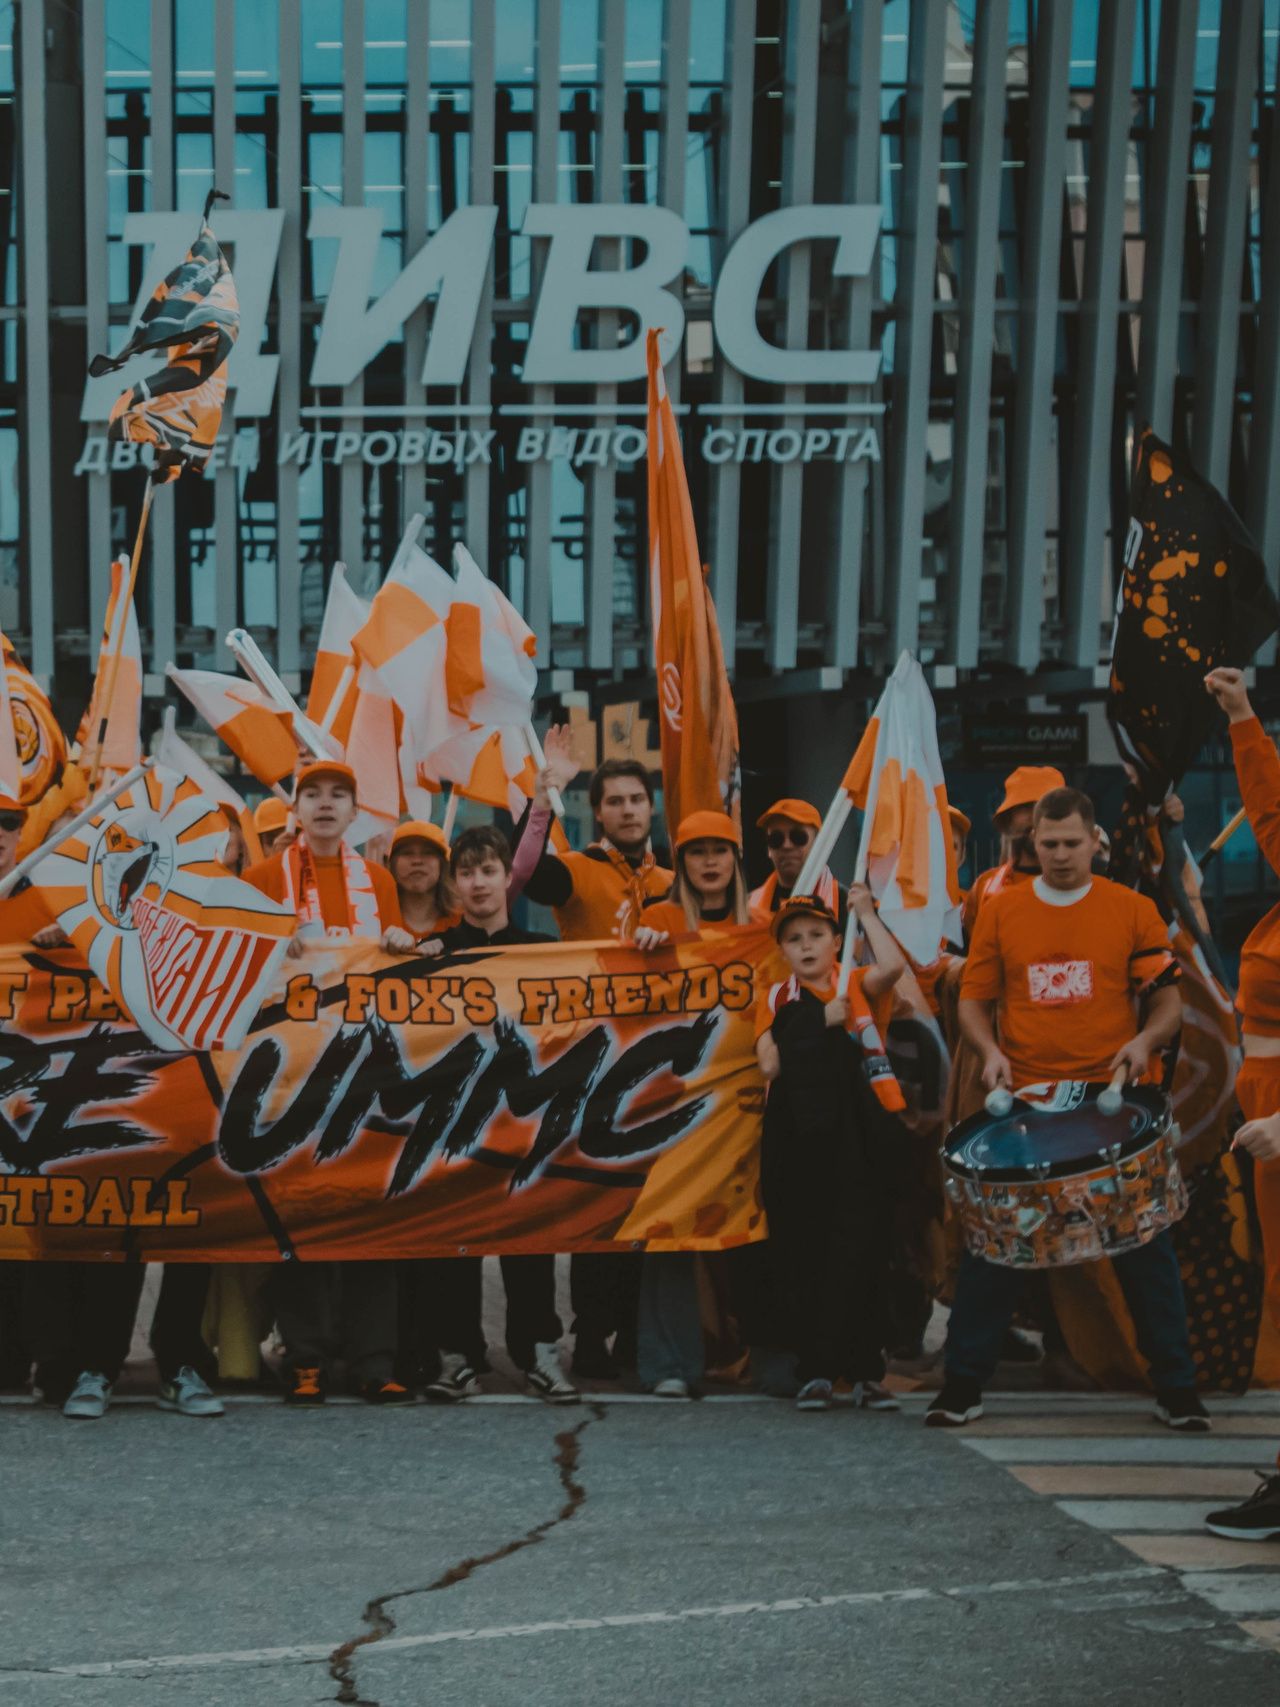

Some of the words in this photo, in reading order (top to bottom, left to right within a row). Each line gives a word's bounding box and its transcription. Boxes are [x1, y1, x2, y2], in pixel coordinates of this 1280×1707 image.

[80, 203, 884, 421] ДИВС
[278, 429, 494, 466] ИГРОВЫХ
[516, 427, 649, 467] ВИДО
[702, 427, 883, 464] СПОРТА
[286, 973, 318, 1022] &
[344, 973, 498, 1026] FOX'S
[519, 961, 755, 1026] FRIENDS
[219, 1012, 721, 1200] UMMC
